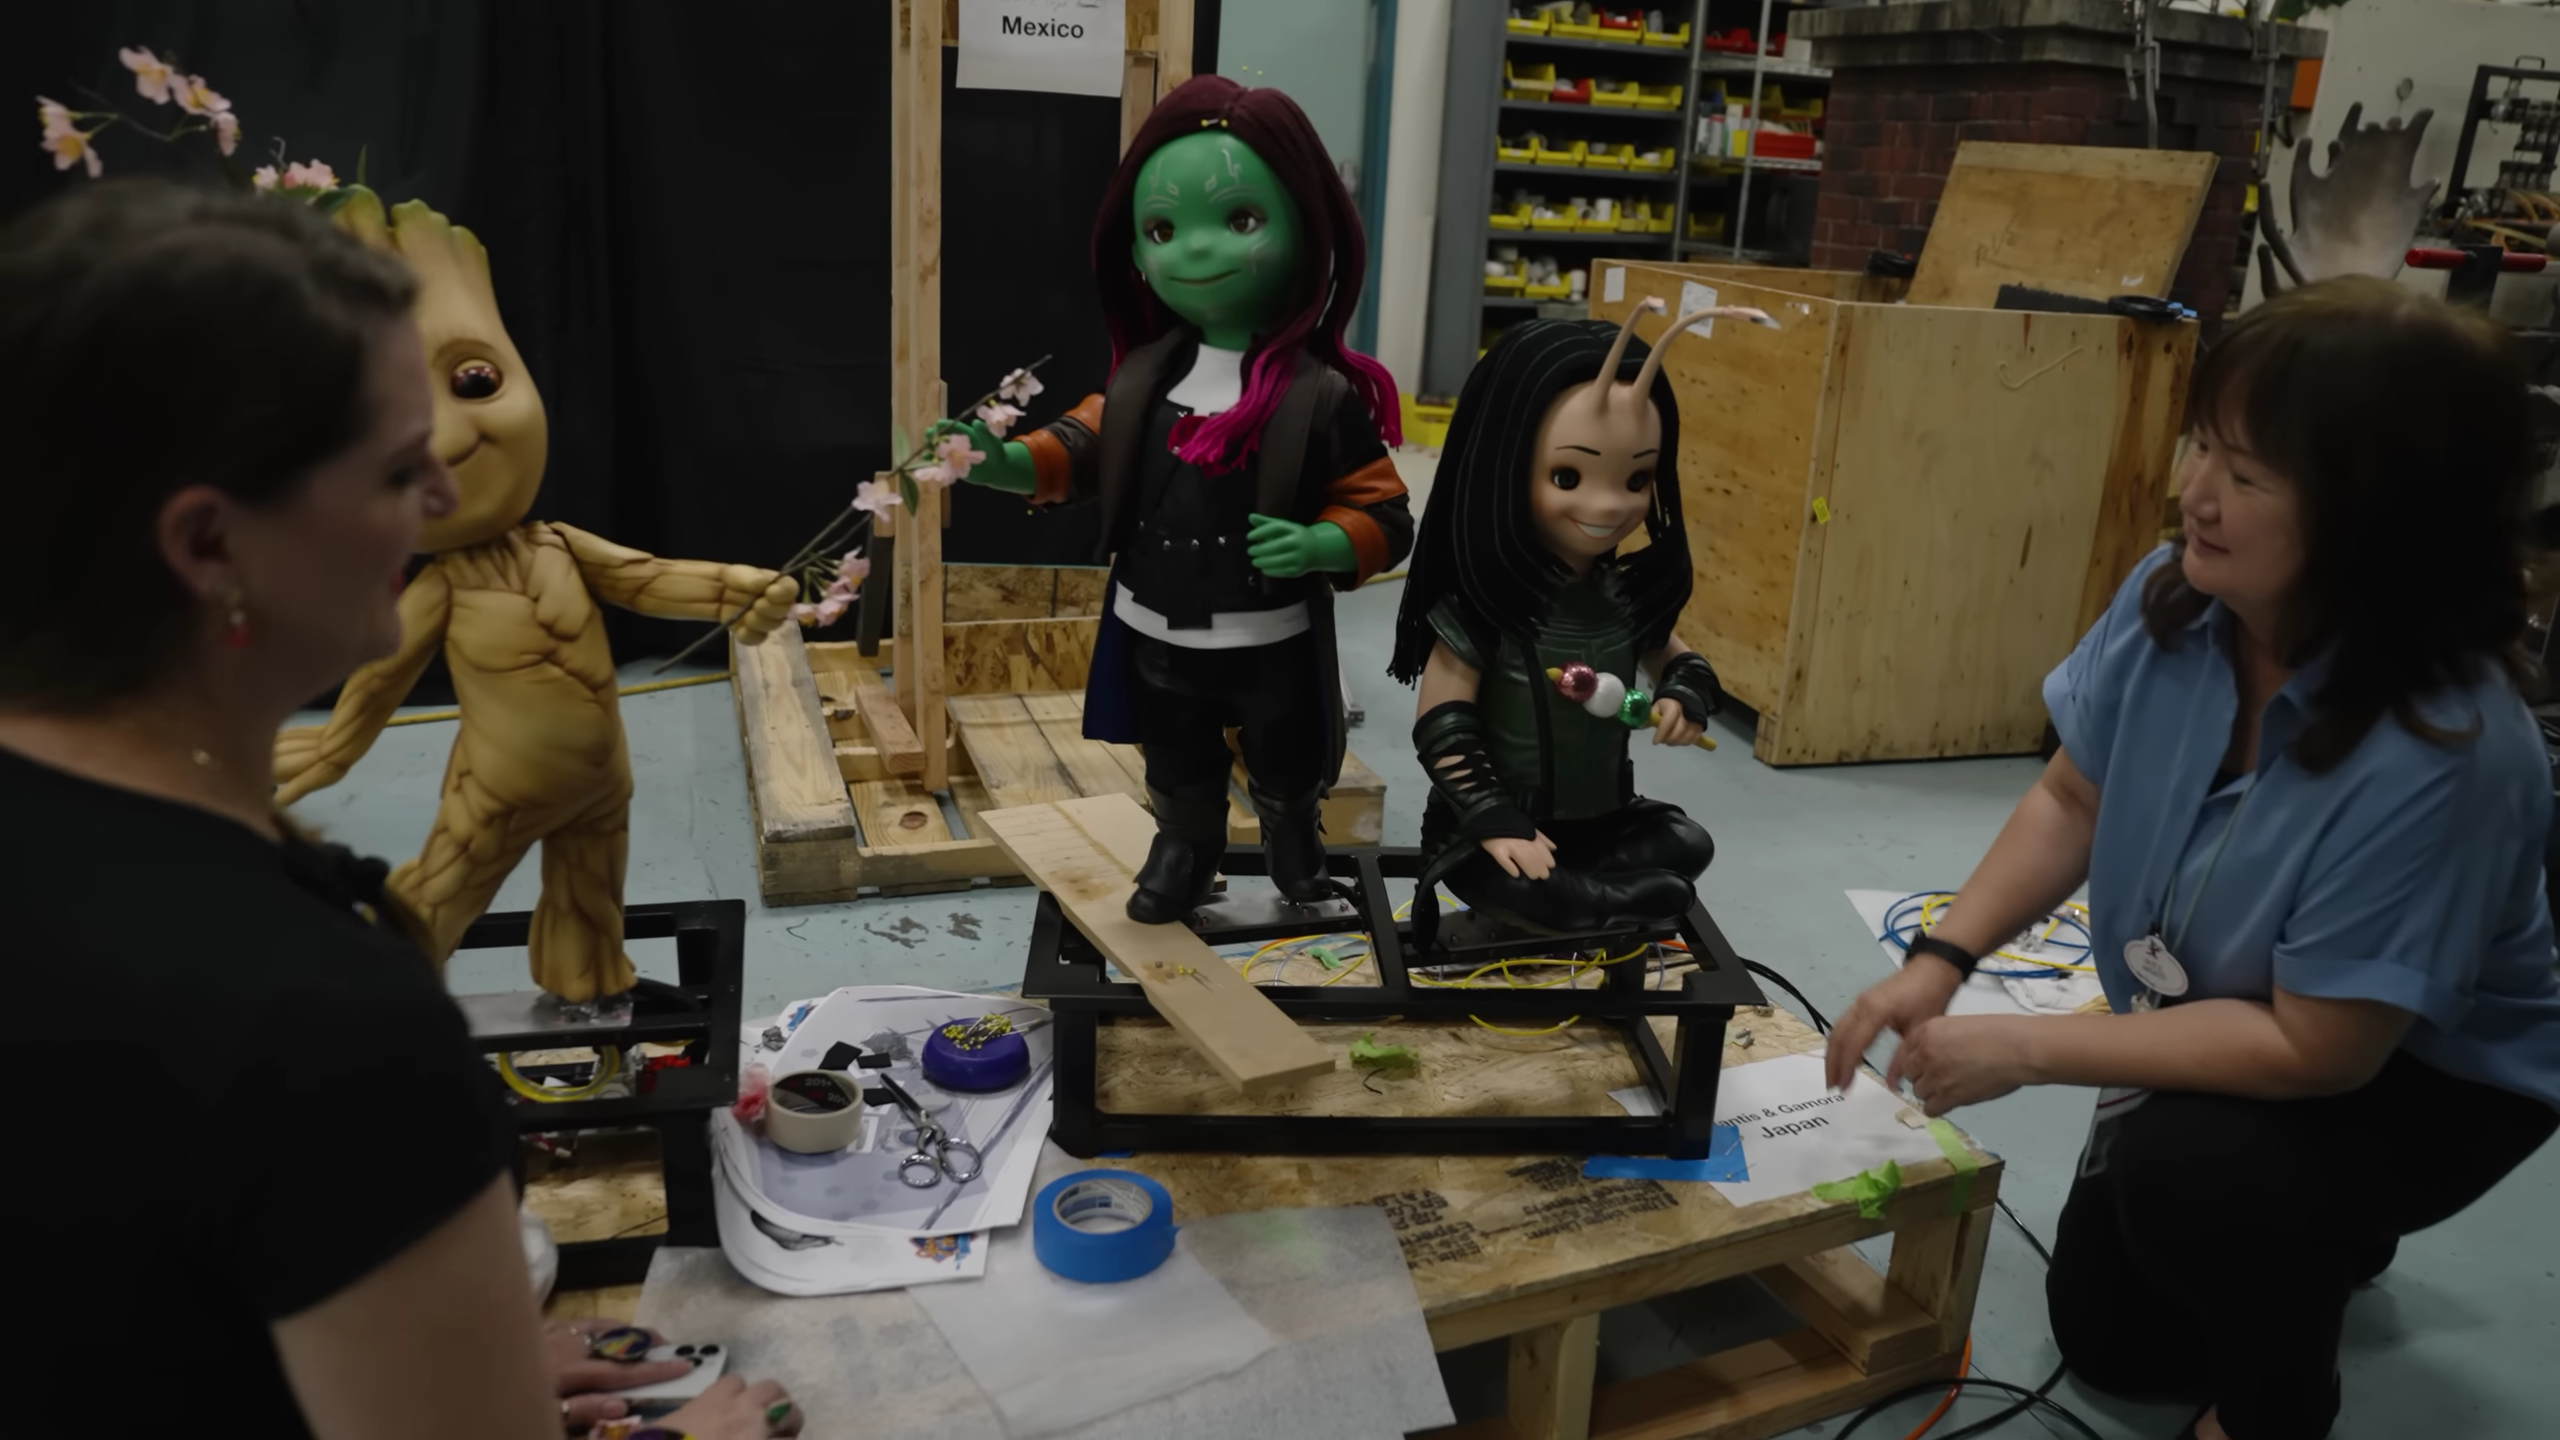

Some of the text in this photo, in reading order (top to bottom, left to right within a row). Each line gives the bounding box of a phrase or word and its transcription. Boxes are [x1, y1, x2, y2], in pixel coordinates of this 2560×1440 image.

[1002, 15, 1084, 38] Mexico
[1717, 1094, 1846, 1127] antis & Gamora
[1761, 1115, 1830, 1139] Japan
